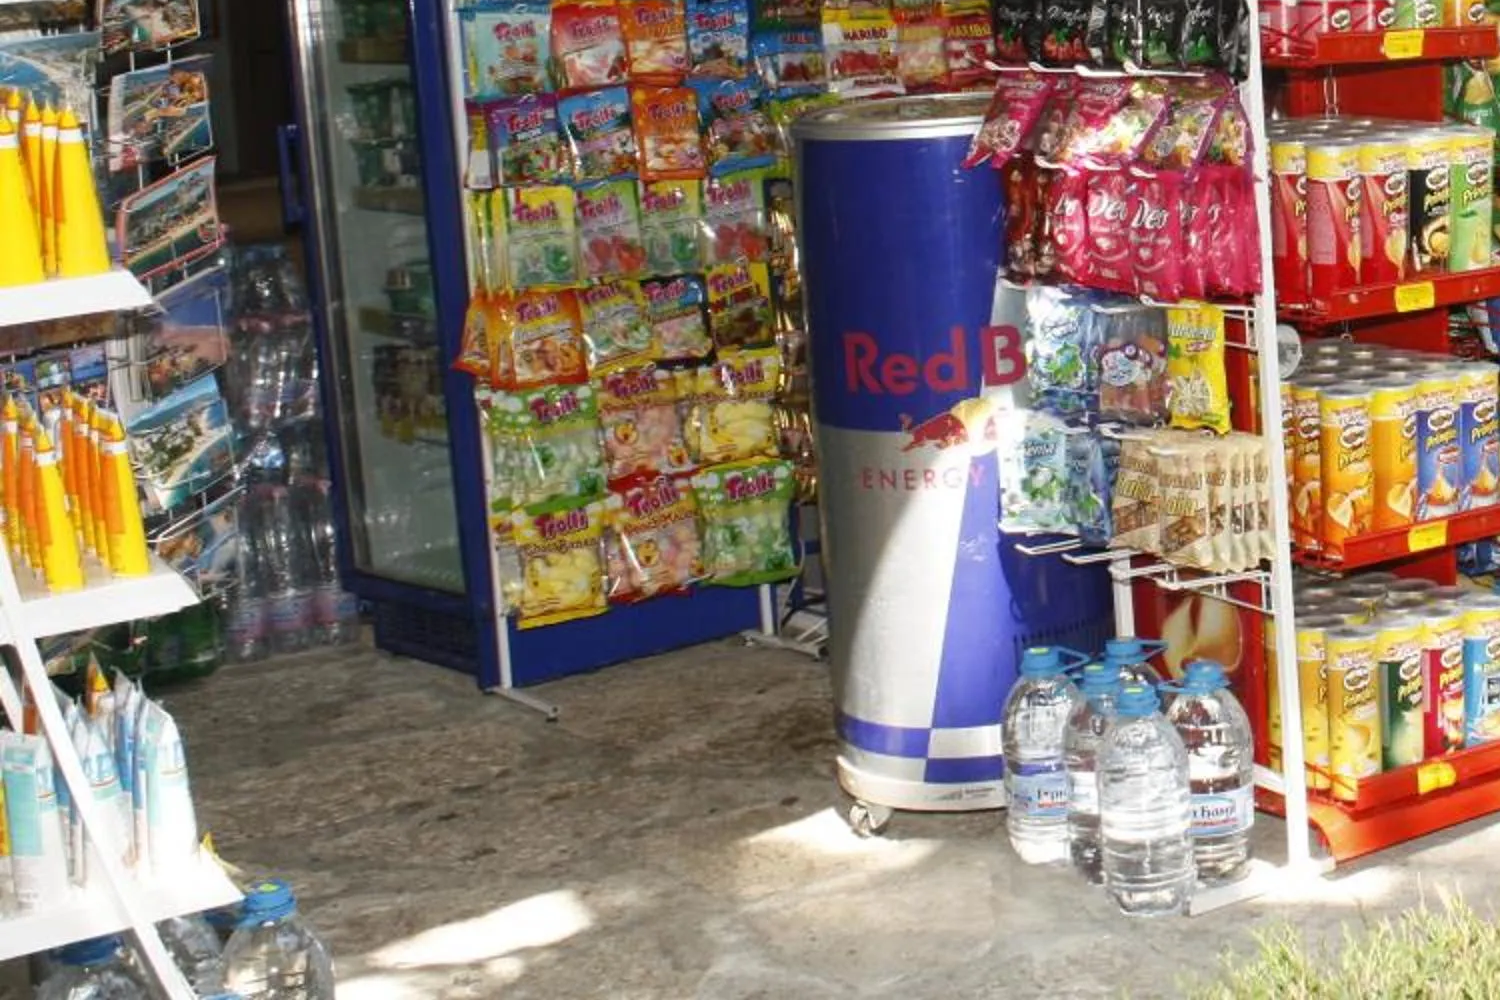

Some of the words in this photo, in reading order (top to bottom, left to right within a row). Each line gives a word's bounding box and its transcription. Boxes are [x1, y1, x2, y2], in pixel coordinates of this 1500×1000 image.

[843, 323, 963, 396] Red
[860, 466, 986, 491] ENERGY
[533, 508, 589, 539] Trolli
